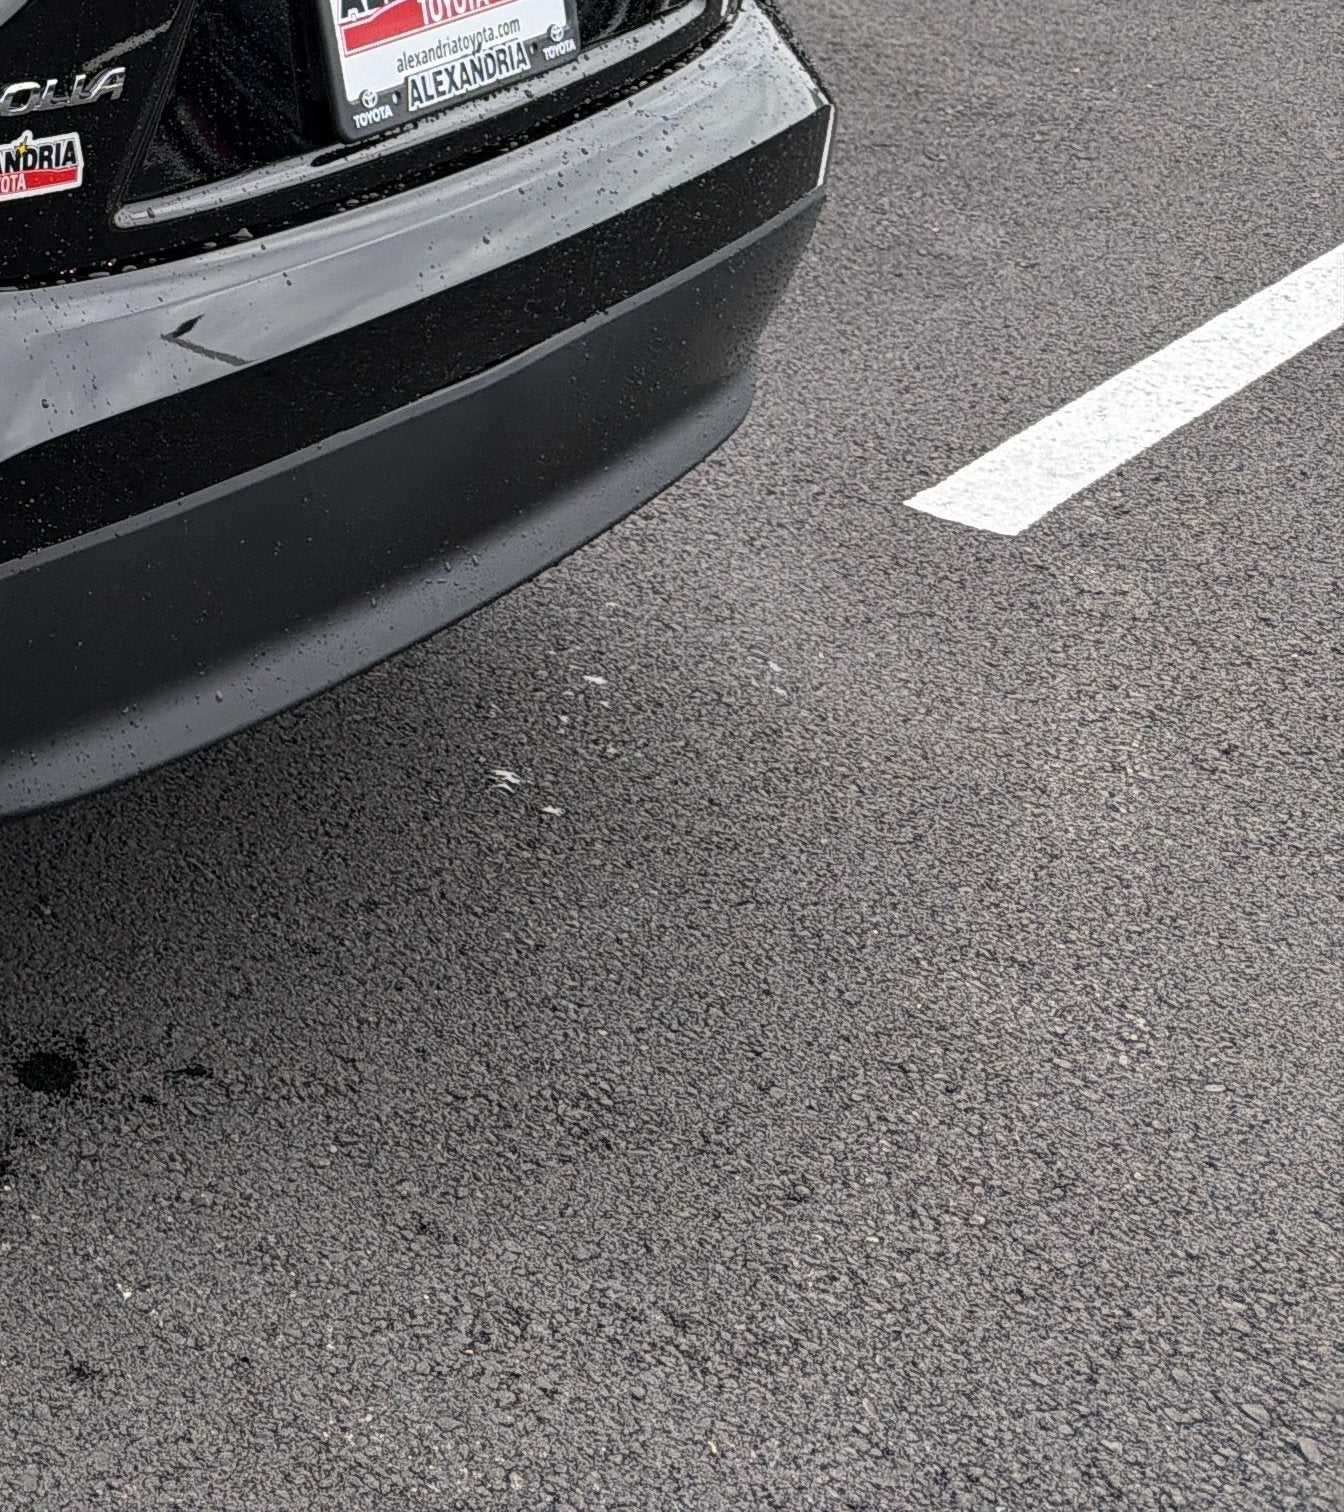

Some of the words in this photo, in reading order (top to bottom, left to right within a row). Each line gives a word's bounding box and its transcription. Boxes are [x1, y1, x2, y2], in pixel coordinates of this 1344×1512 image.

[396, 18, 521, 73] alexandriatoyota.com
[542, 38, 577, 61] TOYOTA
[408, 40, 530, 109] ALEXANDRIA
[352, 104, 394, 129] TOYOTA
